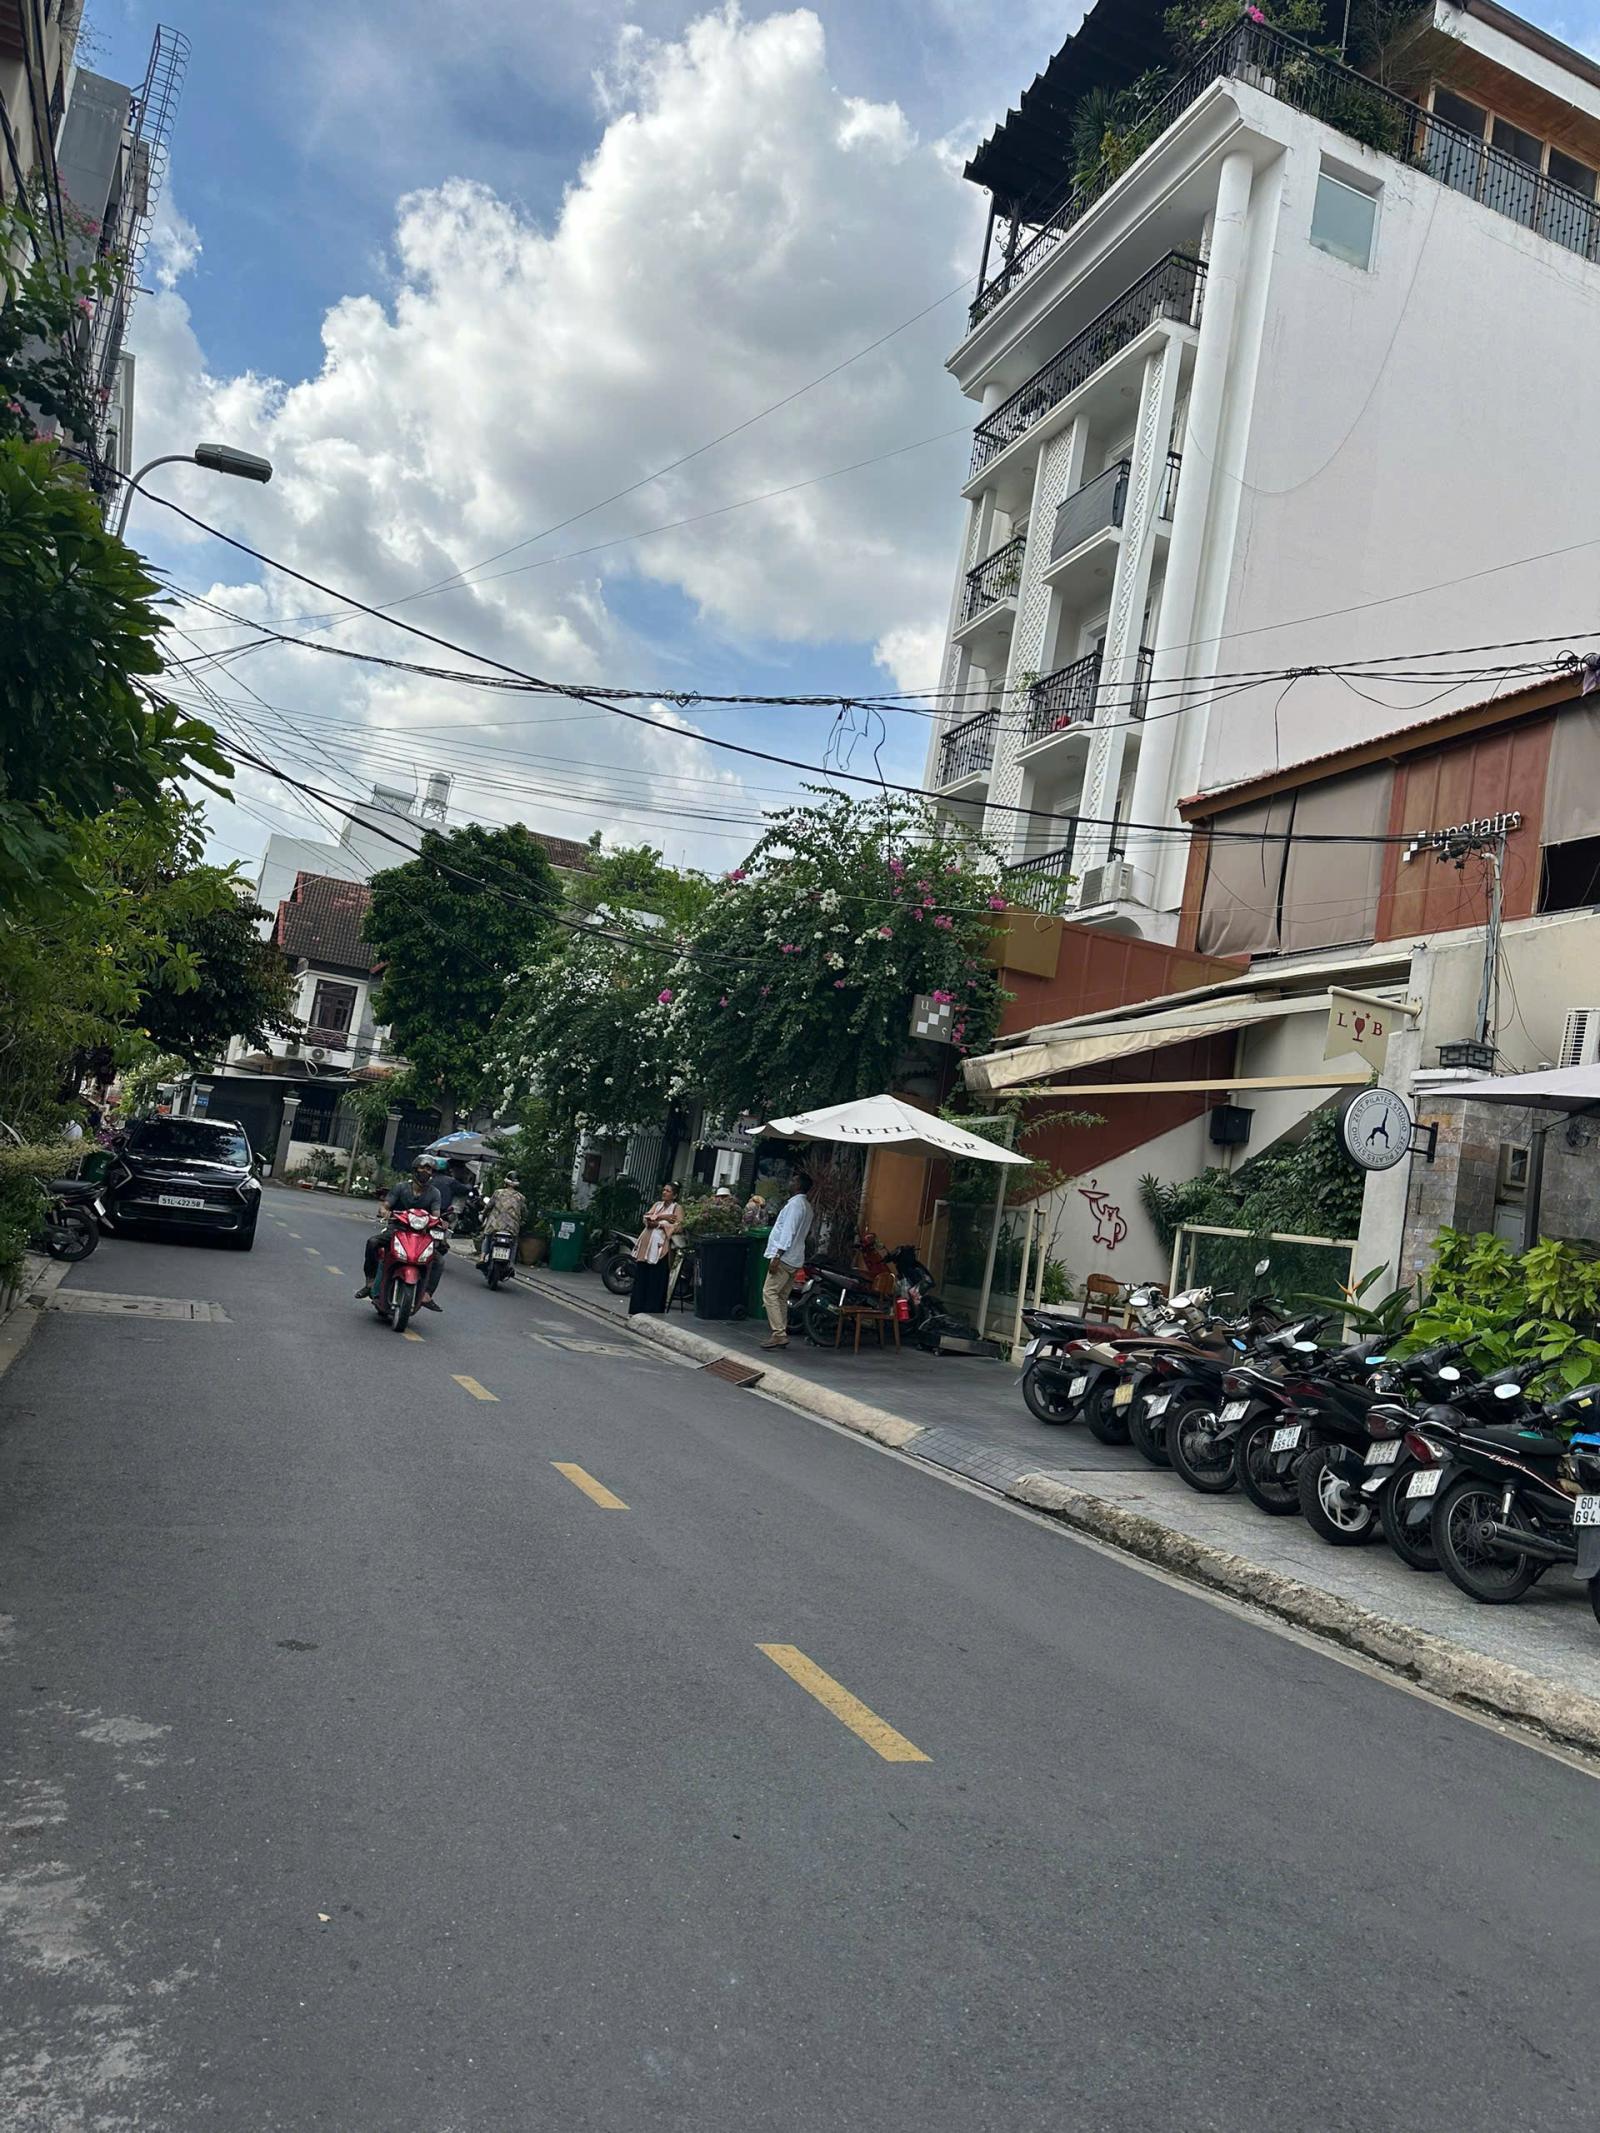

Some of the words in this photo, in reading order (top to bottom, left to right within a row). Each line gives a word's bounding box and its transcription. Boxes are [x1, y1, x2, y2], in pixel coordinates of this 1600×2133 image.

[1336, 1012, 1348, 1028] L
[1371, 1021, 1383, 1036] B
[1353, 1103, 1366, 1122] ZEST
[1365, 1095, 1393, 1106] PILATES
[1393, 1103, 1408, 1132] STUDIO
[1581, 1497, 1600, 1510] 60-
